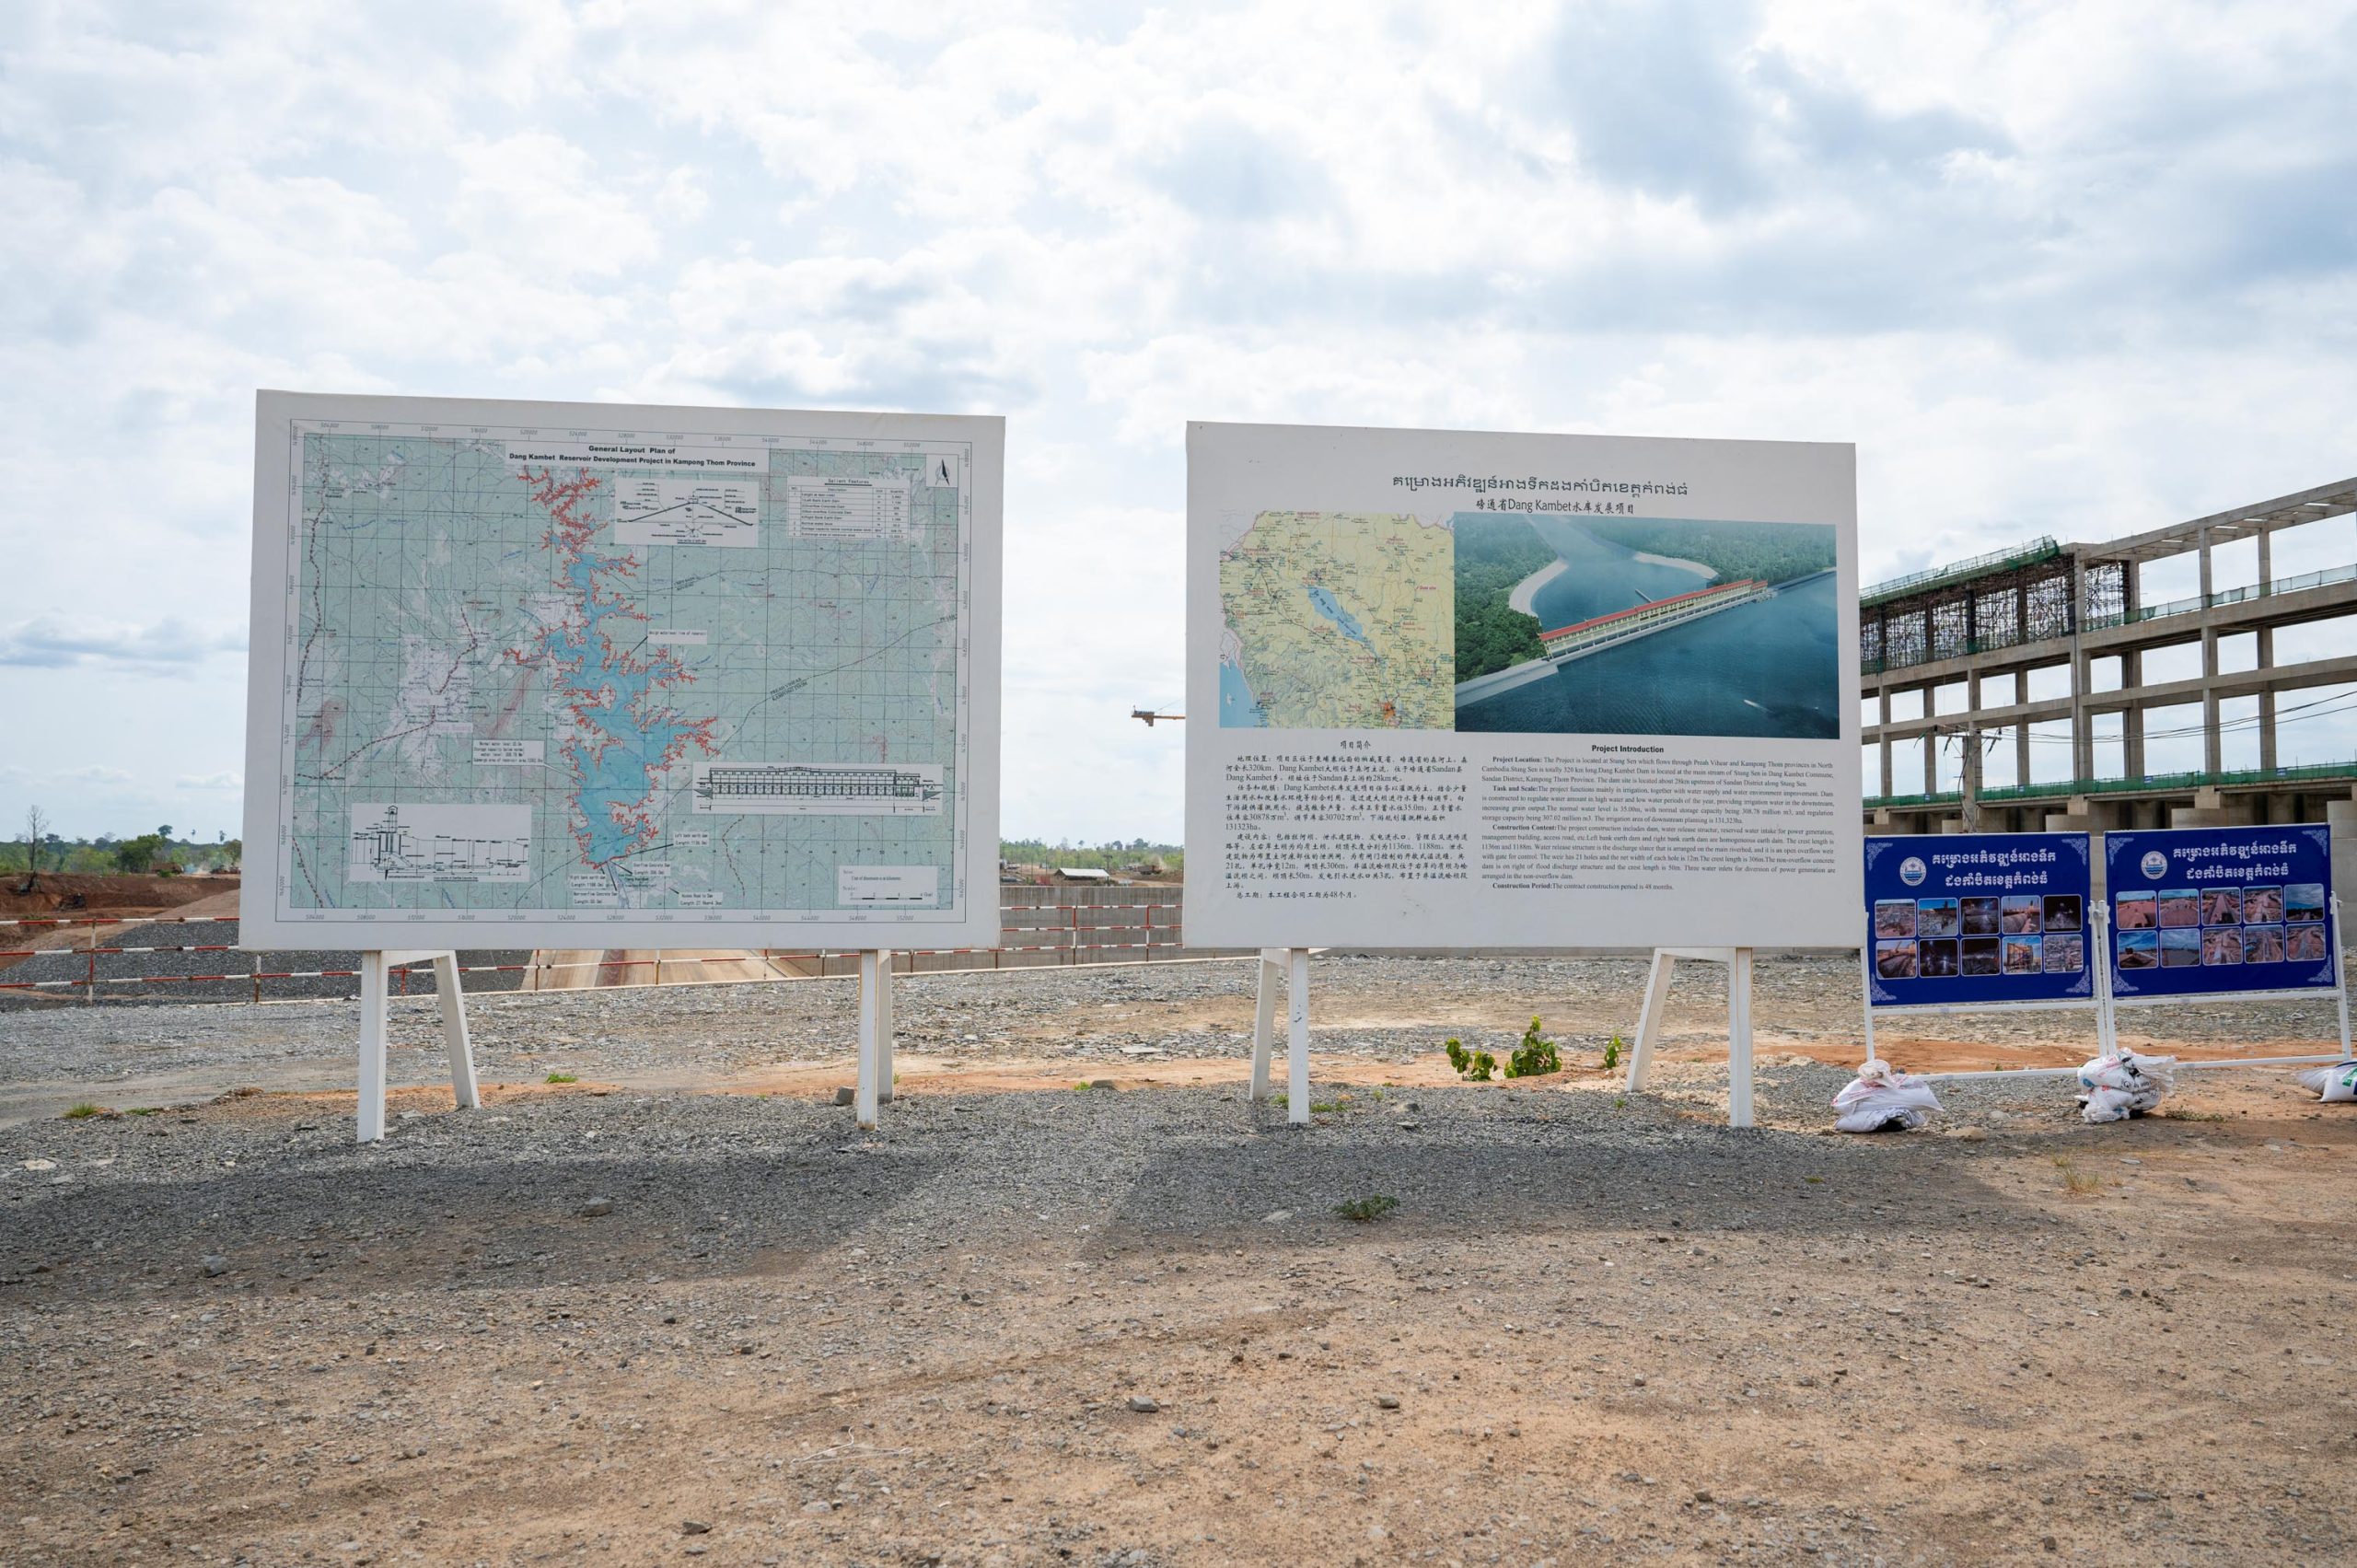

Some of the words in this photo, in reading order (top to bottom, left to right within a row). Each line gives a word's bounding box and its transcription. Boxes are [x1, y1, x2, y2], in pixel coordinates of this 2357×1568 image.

[1341, 740, 1372, 749] 项目简介
[1592, 745, 1618, 754] Project
[1620, 745, 1664, 753] Introduction
[1525, 775, 1552, 784] Kampong
